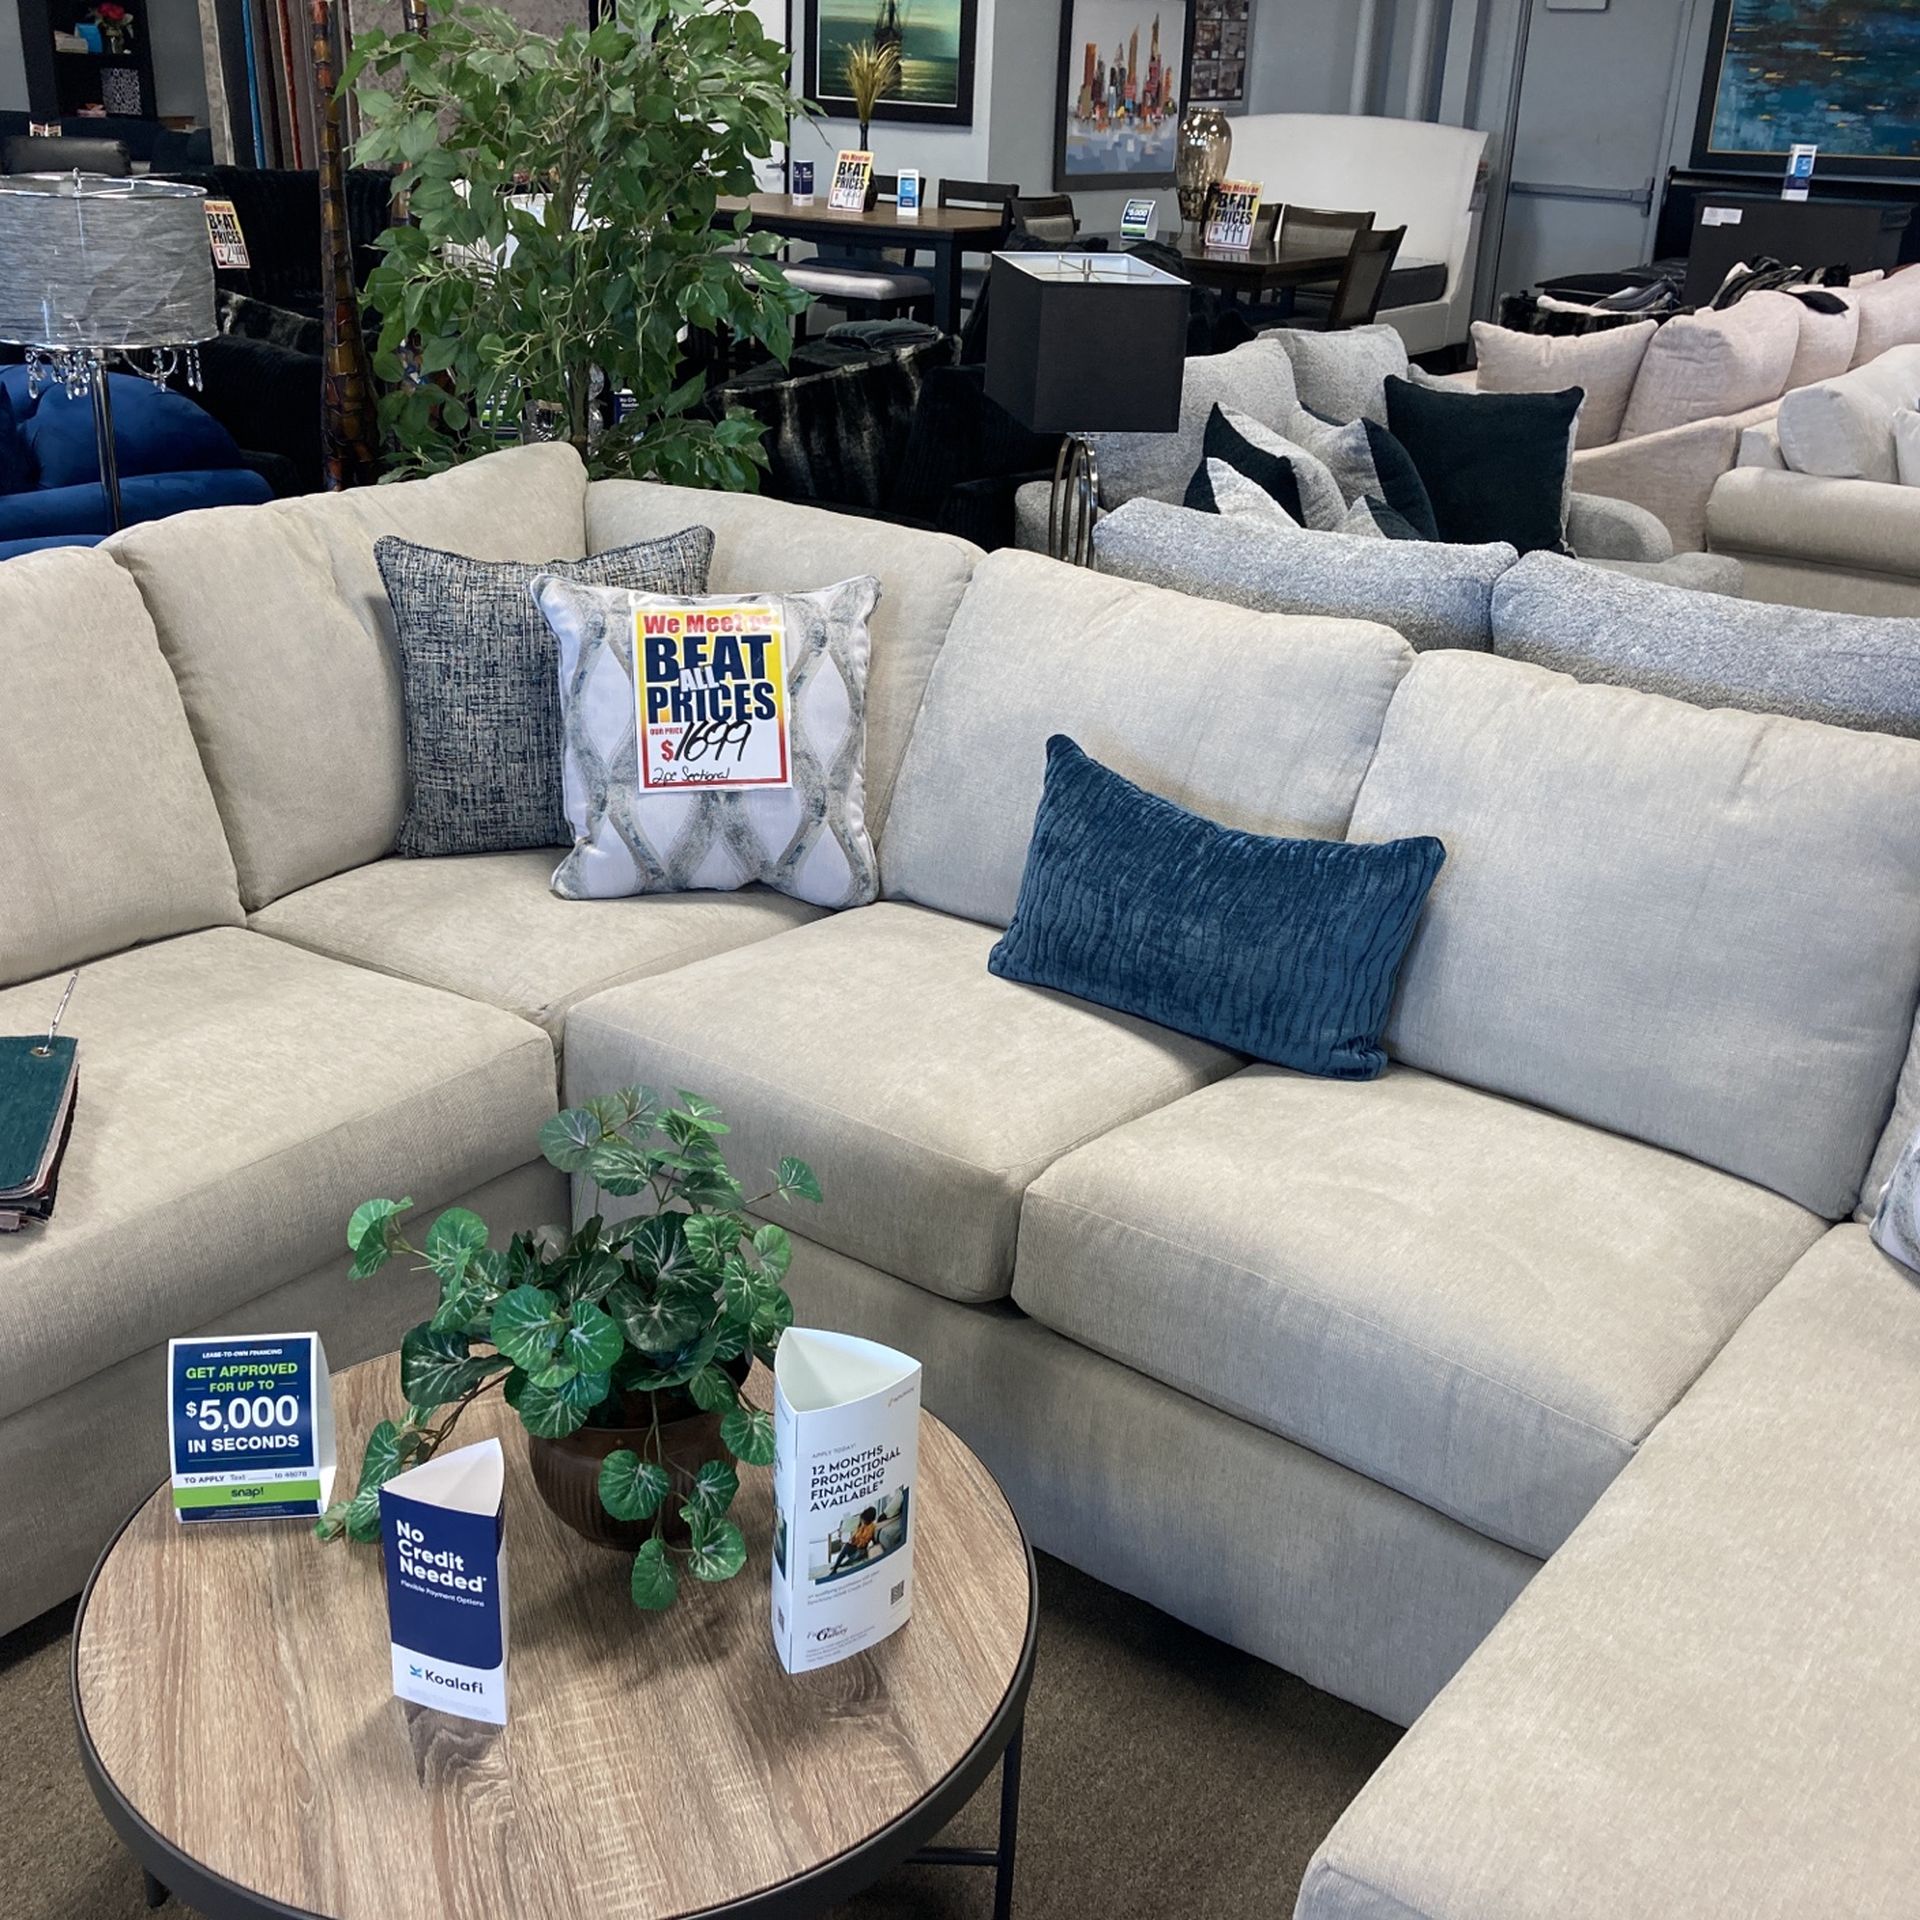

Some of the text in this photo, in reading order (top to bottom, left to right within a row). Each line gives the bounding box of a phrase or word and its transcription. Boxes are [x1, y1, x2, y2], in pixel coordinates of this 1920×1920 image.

[838, 161, 868, 177] BEAT
[835, 177, 865, 190] PRICES
[1218, 192, 1257, 210] BEAT
[207, 213, 236, 230] BEAT
[1214, 209, 1253, 225] PRICES
[211, 230, 243, 244] PRICES
[643, 615, 680, 634] We
[686, 614, 743, 633] Meet
[644, 634, 772, 683] BEAT
[679, 664, 720, 692] ALL
[646, 681, 777, 724] PRICES
[649, 727, 683, 736] OUR PRICE
[249, 1348, 283, 1356] FINANCING
[185, 1362, 298, 1379] GET APPROVED
[209, 1380, 275, 1393] FOR UP TO
[187, 1434, 300, 1453] IN SECONDS
[811, 1444, 884, 1476] 12 MONTHS
[811, 1446, 901, 1488] PROMOTIONAL
[184, 1476, 197, 1484] TO
[198, 1475, 225, 1484] APPLY
[810, 1467, 885, 1500] FINANCING
[231, 1486, 264, 1498] snap!
[396, 1519, 425, 1543] No
[397, 1538, 465, 1572] Credit
[456, 1595, 485, 1608] Options
[425, 1669, 483, 1694] Koalafi
